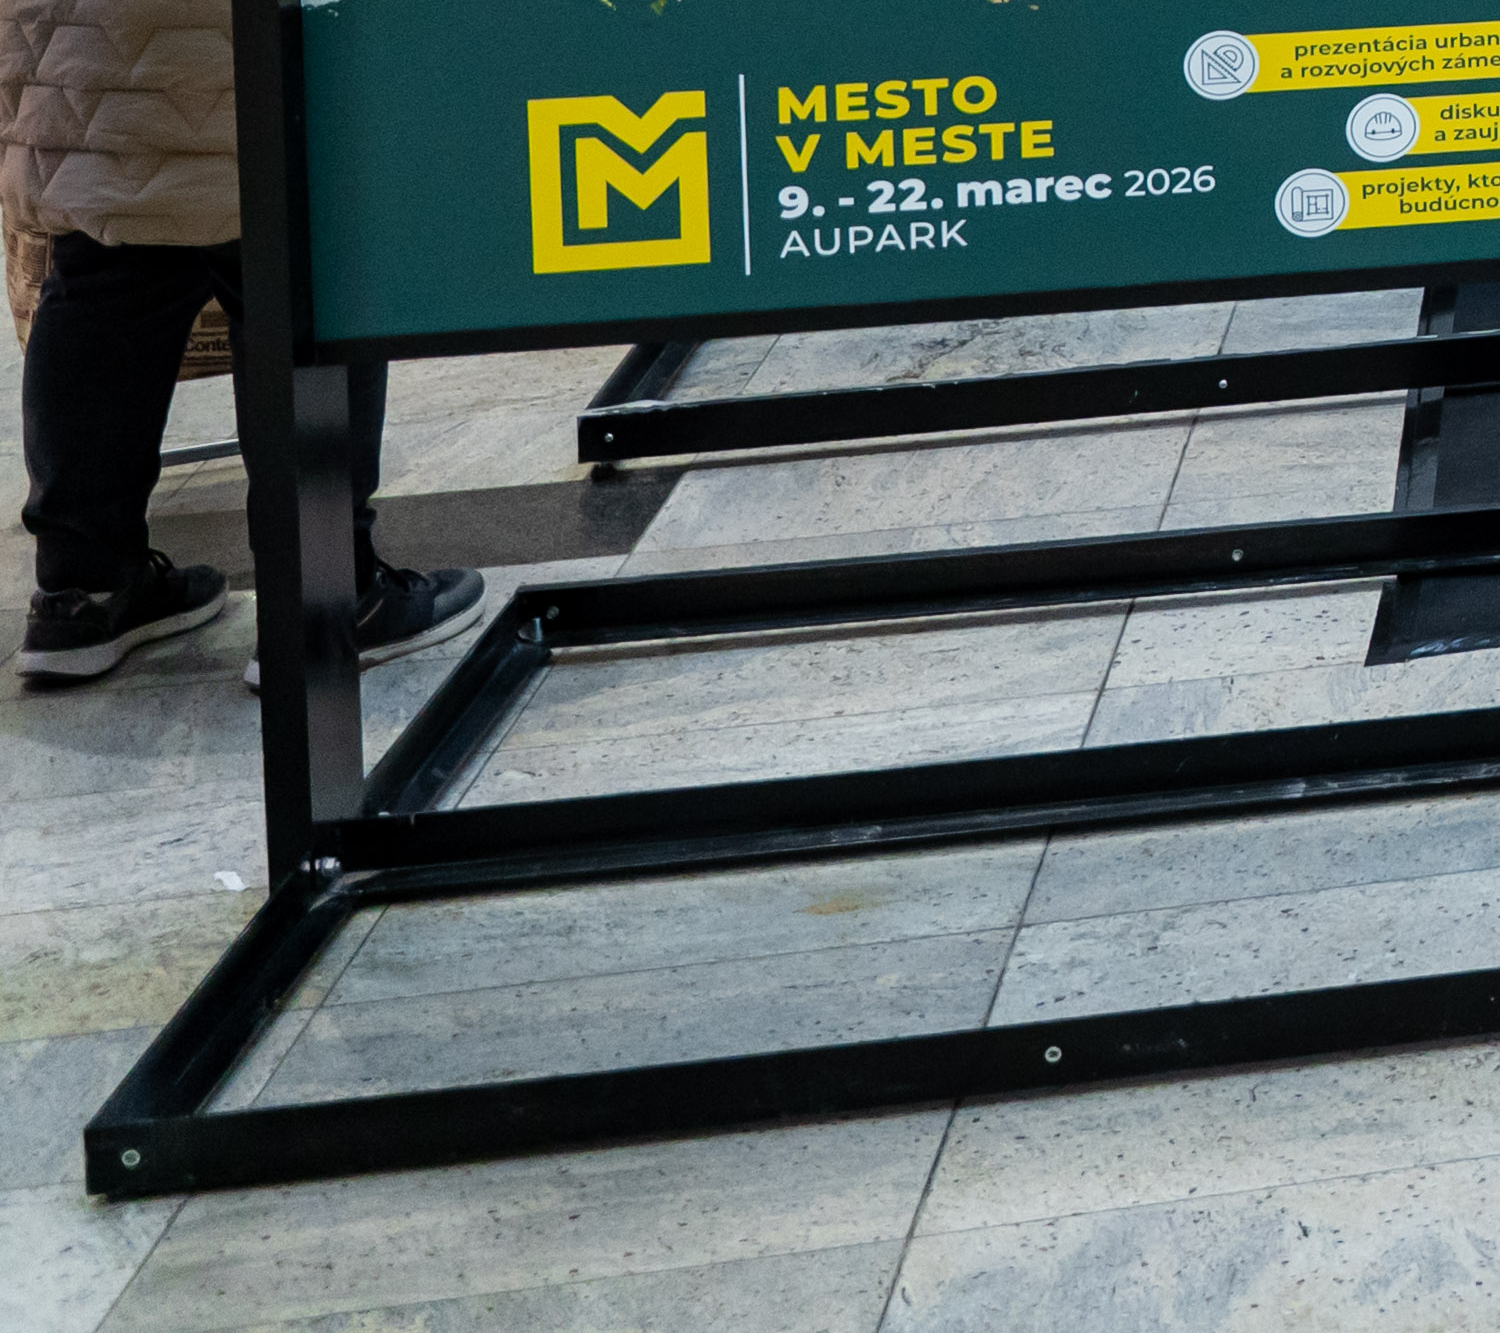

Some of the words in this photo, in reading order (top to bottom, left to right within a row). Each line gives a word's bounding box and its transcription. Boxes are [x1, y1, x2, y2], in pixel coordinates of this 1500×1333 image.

[1294, 34, 1428, 60] prezentácia
[1280, 67, 1293, 79] a
[1299, 55, 1435, 80] rozvojových
[777, 74, 998, 126] MESTO
[776, 133, 821, 172] V
[845, 119, 1055, 170] MESTE
[1434, 130, 1447, 142] a
[779, 185, 825, 220] 9.
[866, 177, 944, 214] 22.
[956, 171, 1113, 209] marec
[1124, 164, 1217, 199] 2026
[1361, 174, 1461, 201] projekty,
[779, 219, 969, 259] AUPARK
